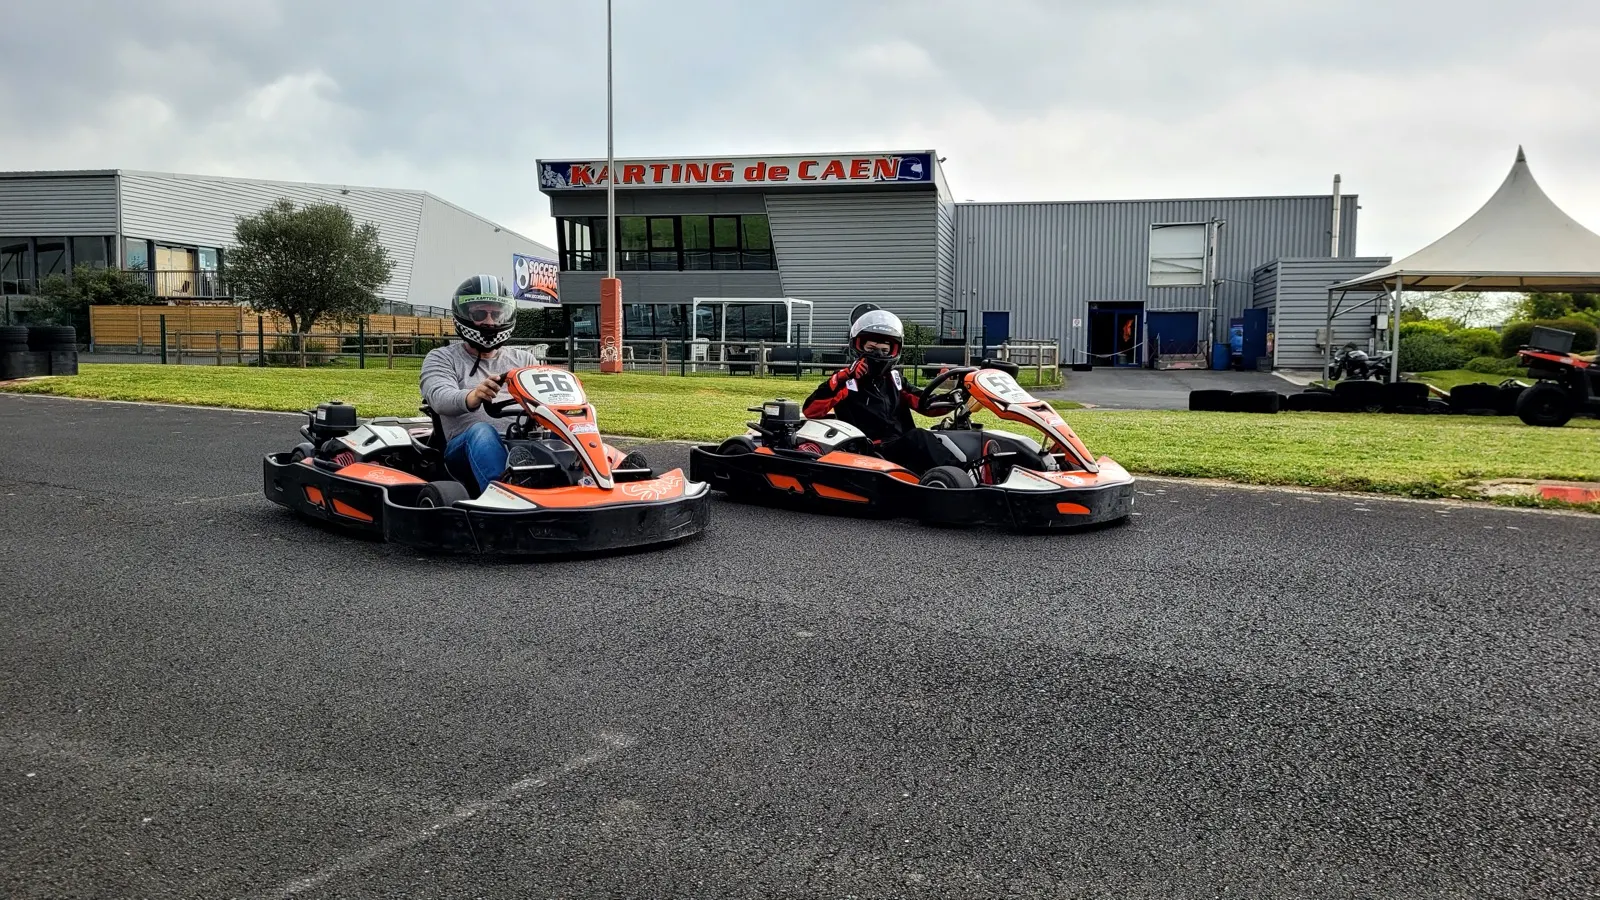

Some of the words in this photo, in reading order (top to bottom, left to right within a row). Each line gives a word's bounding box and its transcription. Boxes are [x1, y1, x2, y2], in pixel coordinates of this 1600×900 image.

[569, 162, 733, 186] KARTING
[744, 161, 790, 182] de
[797, 157, 902, 181] CAEN
[529, 260, 558, 277] SOCCER
[529, 273, 558, 290] INDOOR
[531, 373, 574, 394] 56
